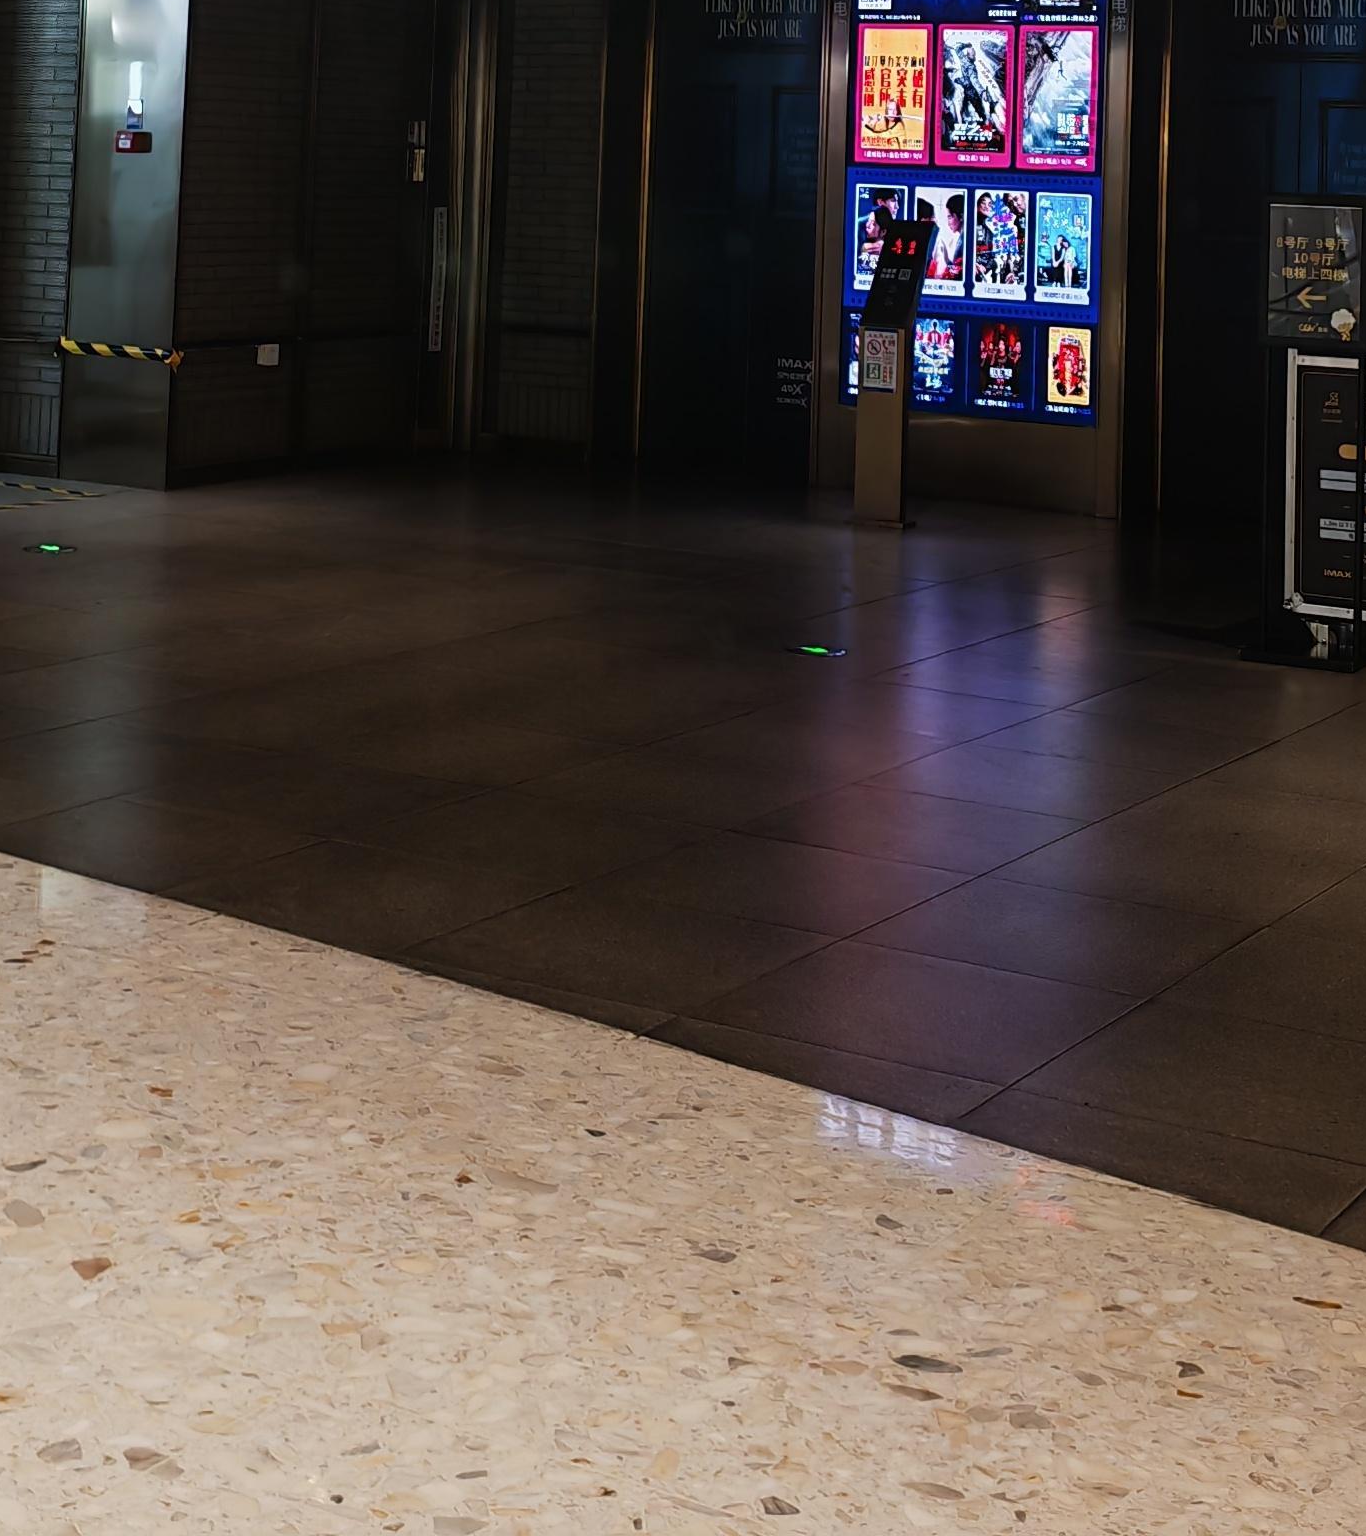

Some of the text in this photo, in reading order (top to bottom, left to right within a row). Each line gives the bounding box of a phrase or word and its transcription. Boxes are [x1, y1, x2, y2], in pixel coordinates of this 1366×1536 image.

[1249, 23, 1359, 48] JUST AS YOU ARE
[1315, 237, 1350, 251] 9号厅
[1293, 252, 1336, 267] 10号厅
[1323, 569, 1353, 578] IMAX
